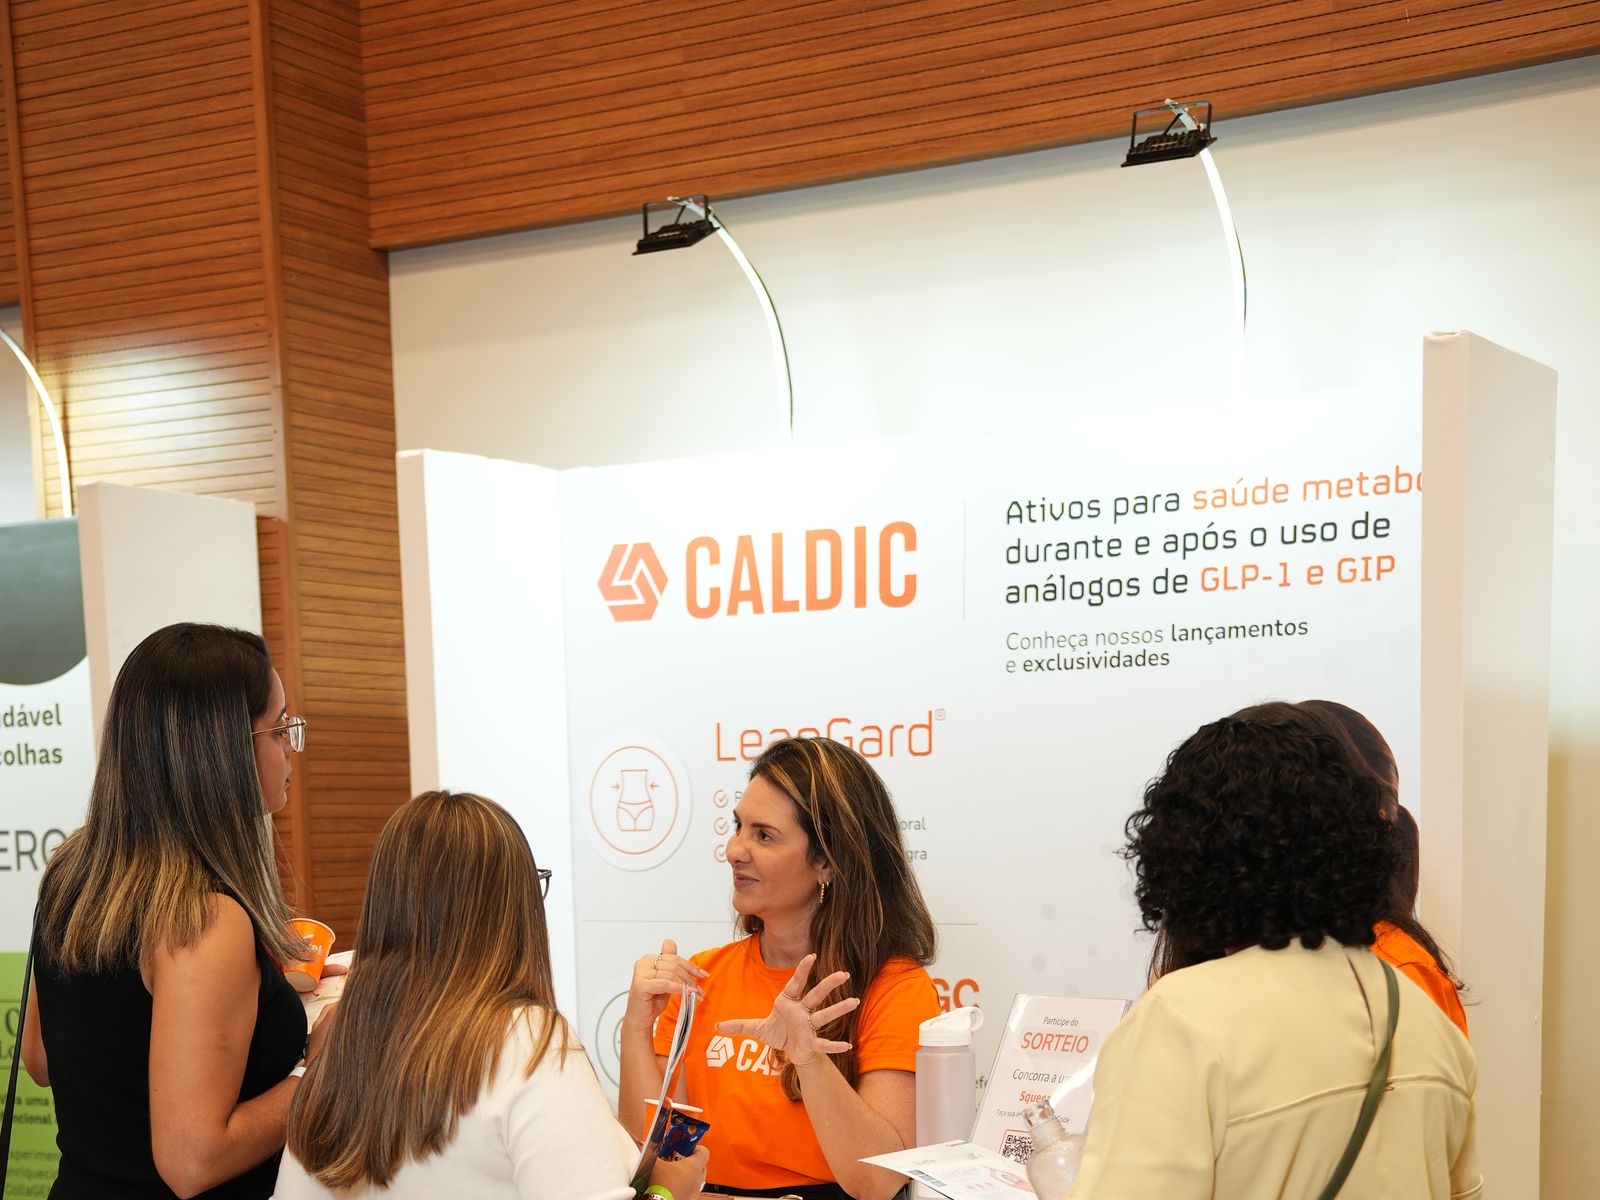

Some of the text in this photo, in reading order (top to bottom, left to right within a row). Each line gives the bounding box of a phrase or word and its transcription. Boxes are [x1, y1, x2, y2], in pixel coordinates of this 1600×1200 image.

[1007, 497, 1101, 524] Ativos
[1114, 493, 1180, 524] para
[1193, 477, 1289, 510] saúde
[1006, 511, 1390, 564] durante e após o uso de
[685, 521, 917, 619] CALDIC
[1006, 555, 1396, 607] análogos de GLP-1 e GIP
[1006, 619, 1308, 651] Conheça nossos lançamentos
[1006, 649, 1170, 673] e exclusividades
[0, 703, 62, 727] dável
[0, 743, 63, 766] olhas
[1043, 1016, 1079, 1028] Participe do
[1021, 1031, 1089, 1053] SORTEIO
[1013, 1068, 1050, 1083] Concorra
[1051, 1074, 1058, 1083] a
